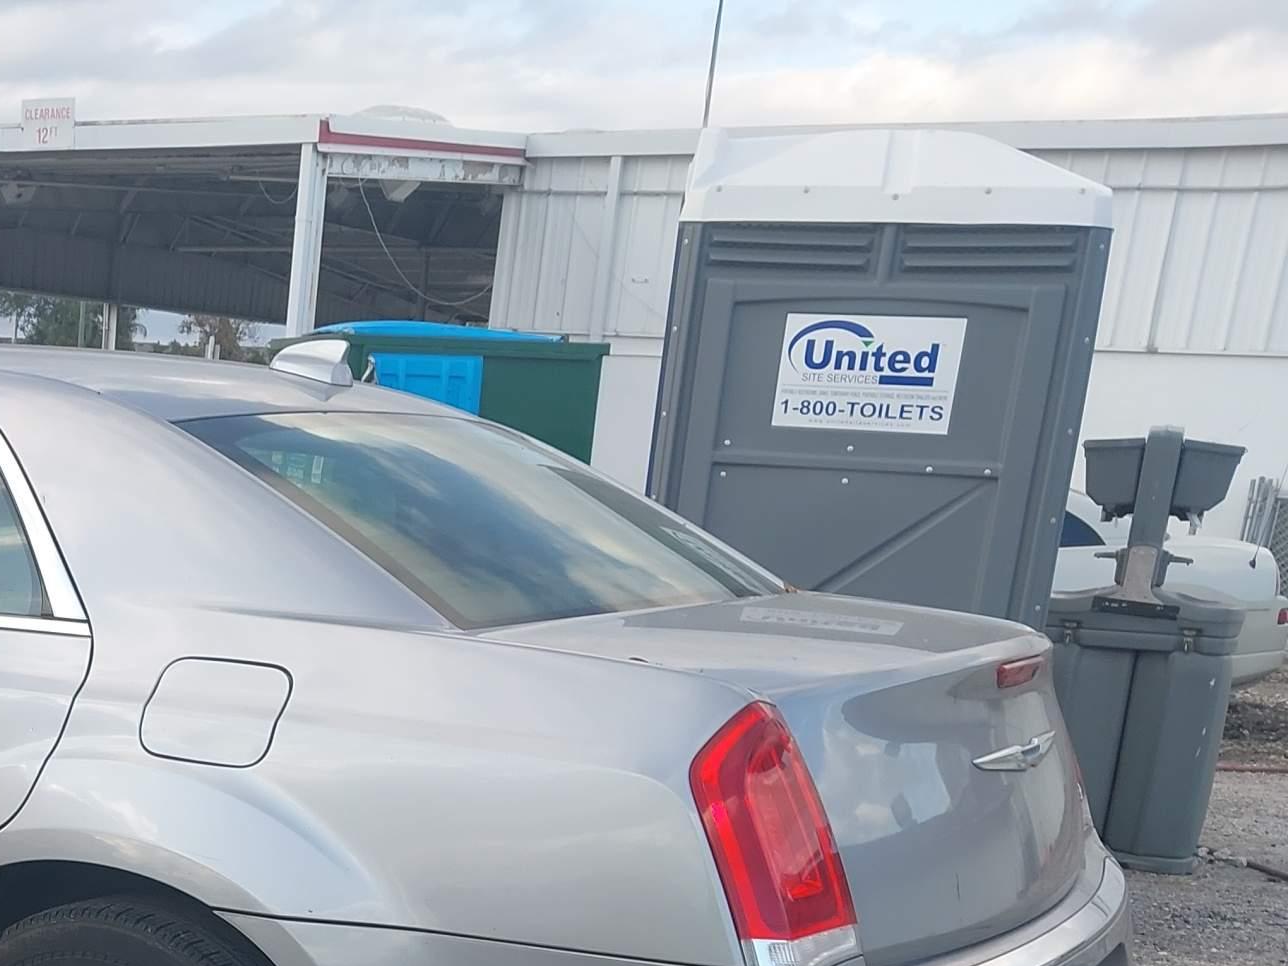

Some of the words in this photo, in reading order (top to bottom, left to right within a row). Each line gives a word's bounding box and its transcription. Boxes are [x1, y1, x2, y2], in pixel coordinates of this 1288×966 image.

[25, 107, 71, 120] CLEARANCE
[37, 127, 48, 144] 12
[804, 339, 940, 373] United
[801, 373, 824, 383] SITE
[826, 373, 878, 385] SERVICES
[780, 399, 944, 421] 1-800-TOILETS
